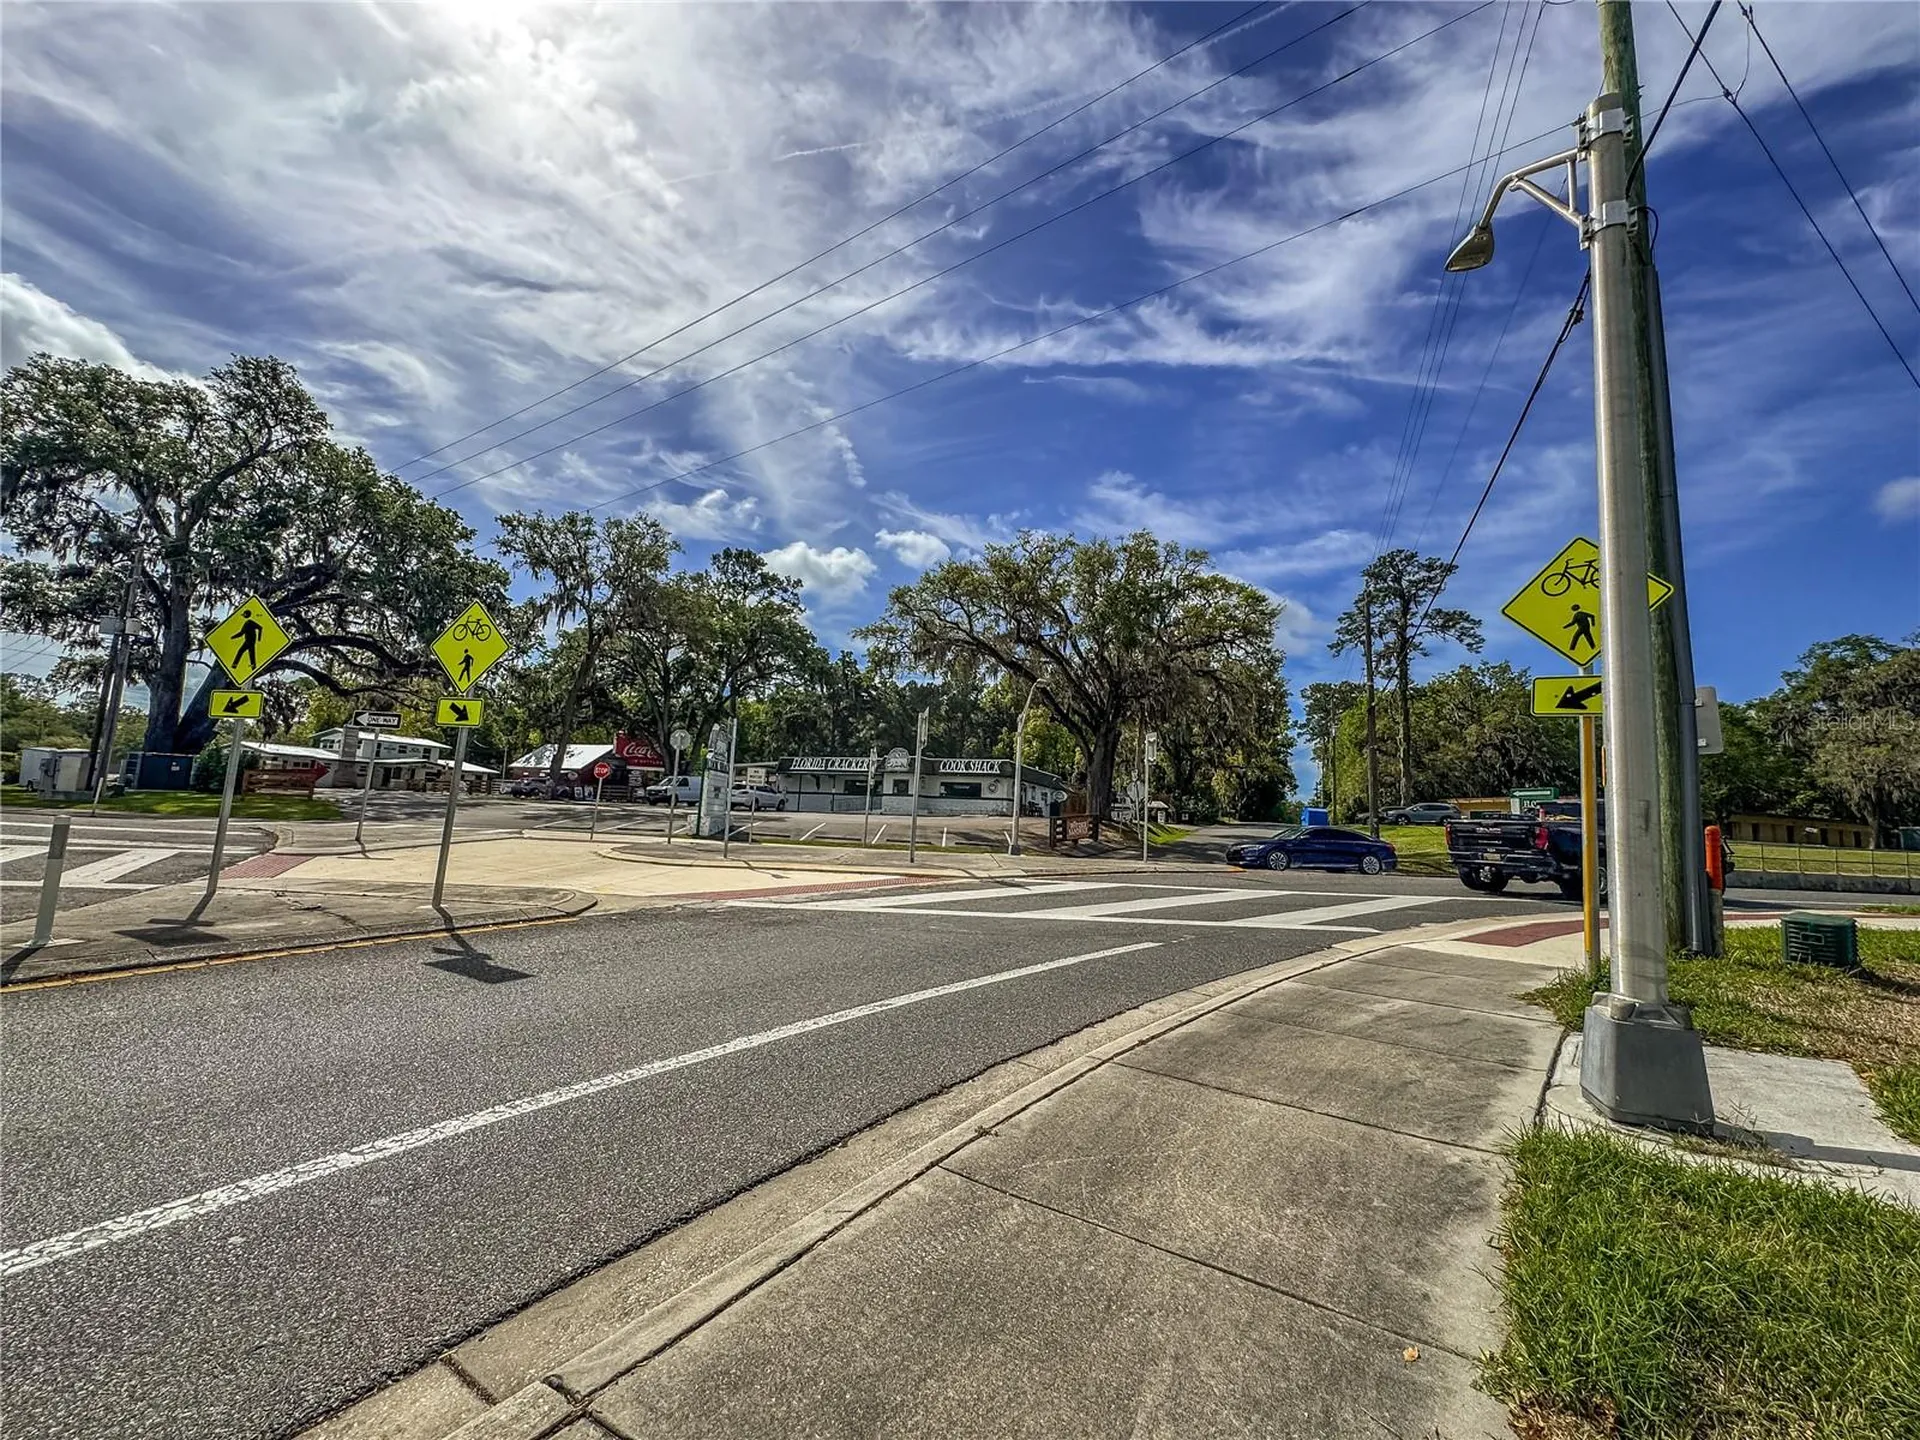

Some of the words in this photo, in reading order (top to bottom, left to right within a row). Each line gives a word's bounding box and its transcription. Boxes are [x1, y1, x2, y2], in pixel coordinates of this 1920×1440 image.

[367, 716, 380, 724] ONE
[623, 742, 660, 759] Coca-C
[789, 757, 826, 770] FLORIDA
[938, 759, 968, 773] COOK
[969, 759, 1001, 774] SHACK
